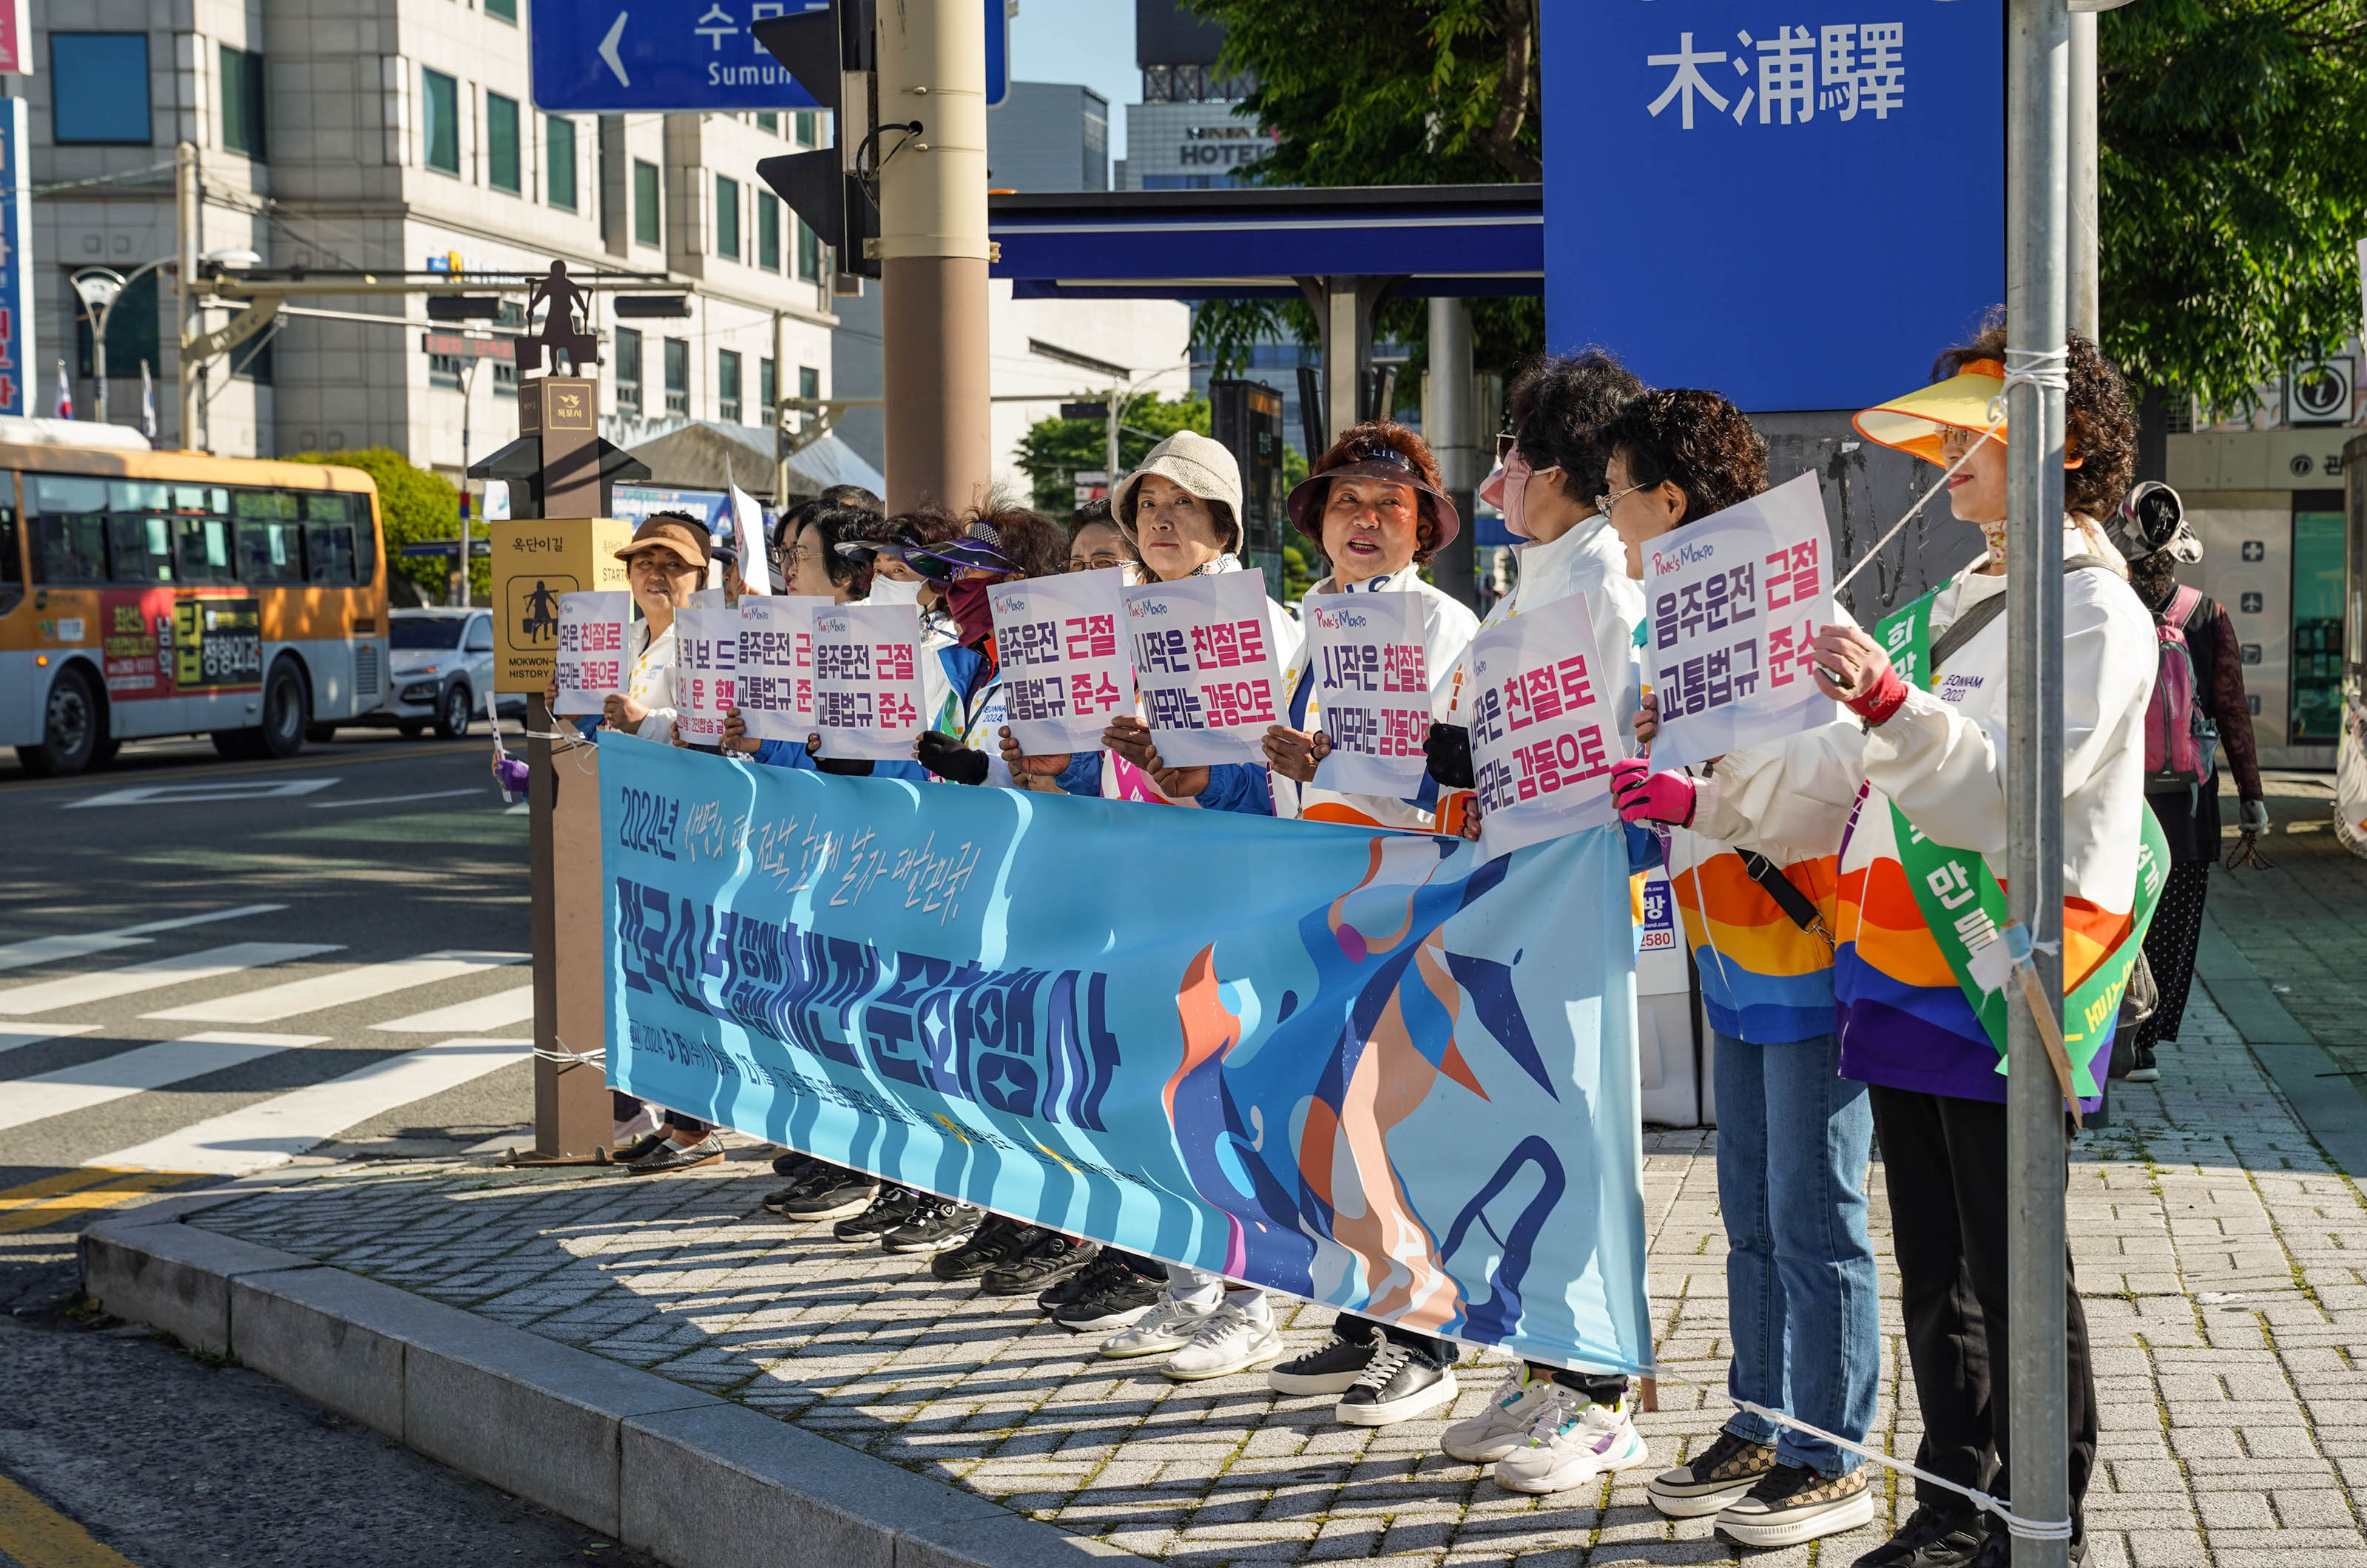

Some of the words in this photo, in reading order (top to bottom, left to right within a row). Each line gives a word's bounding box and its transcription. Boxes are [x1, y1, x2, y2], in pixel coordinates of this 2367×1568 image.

[1647, 22, 1905, 129] 木浦驛
[558, 408, 581, 418] 목포시
[513, 536, 564, 553] 옥단이길
[603, 568, 624, 582] START
[1656, 562, 1756, 650] 음주운전
[1766, 538, 1820, 611] 근절
[581, 623, 621, 652] 친절로
[739, 631, 790, 666] 음주운전
[796, 633, 813, 666] 근
[999, 621, 1059, 668] 음주운전
[1065, 614, 1116, 660] 근절
[1134, 629, 1190, 674] 시작은
[1190, 619, 1267, 669] 친절로
[509, 658, 556, 666] MOKWON-
[510, 669, 549, 678] HISTORY
[581, 661, 619, 689] 감동으로
[817, 644, 870, 680] 음주운전
[876, 643, 914, 680] 근절
[1323, 645, 1379, 692] 시작은
[1383, 643, 1428, 693] 친절로
[676, 677, 735, 712] 전운행
[737, 675, 792, 711] 교통법규
[797, 679, 813, 712] 준
[1004, 676, 1067, 721] 교통법규
[1071, 671, 1121, 716] 준수
[1504, 655, 1596, 731] 친절로
[1659, 638, 1760, 723] 교통법규
[1941, 688, 1965, 702] 2023
[818, 692, 874, 728] 교통법규
[879, 692, 917, 728] 준수
[983, 705, 1006, 714] EONNA
[983, 714, 1003, 723] 2024
[1142, 686, 1205, 731] 마무리는
[1201, 679, 1277, 728] 감동으로
[691, 717, 714, 734] 2인탑승
[716, 719, 726, 735] 금
[1327, 707, 1377, 754] 마무리는
[1512, 725, 1610, 801] 감동으로
[620, 786, 679, 861] 2024년
[684, 800, 726, 863] 생명의
[756, 814, 799, 893] 전남
[891, 830, 982, 927] 대한민국
